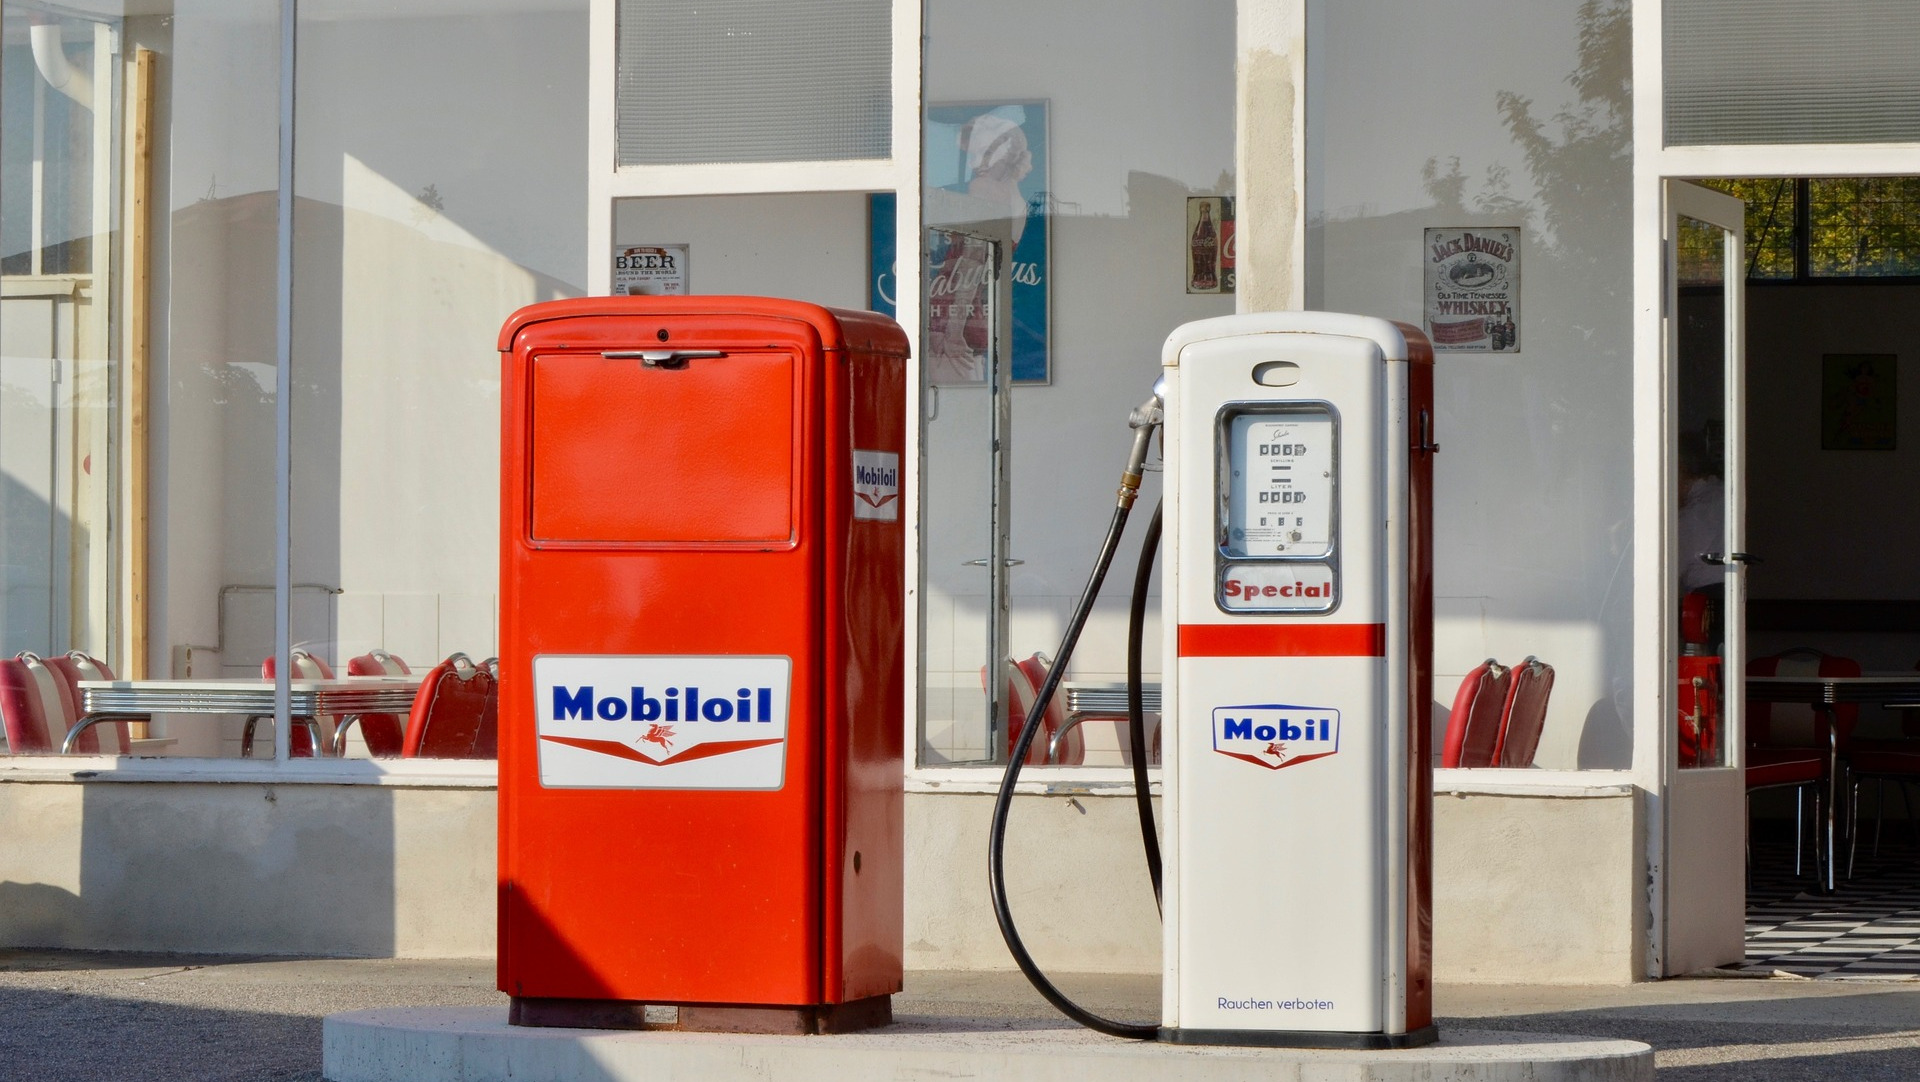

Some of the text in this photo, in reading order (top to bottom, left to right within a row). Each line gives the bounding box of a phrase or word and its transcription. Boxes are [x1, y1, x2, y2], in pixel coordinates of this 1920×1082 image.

[1431, 233, 1514, 263] JACK DANIEL'S
[616, 255, 675, 269] BEER
[1437, 292, 1451, 300] OLD
[1437, 301, 1510, 315] WHISKEY
[856, 465, 896, 487] Mobiloil
[1224, 579, 1331, 601] Special
[552, 685, 772, 723] Mobiloil
[1223, 718, 1330, 741] Mobil
[1217, 997, 1334, 1010] Rauchen verboten
